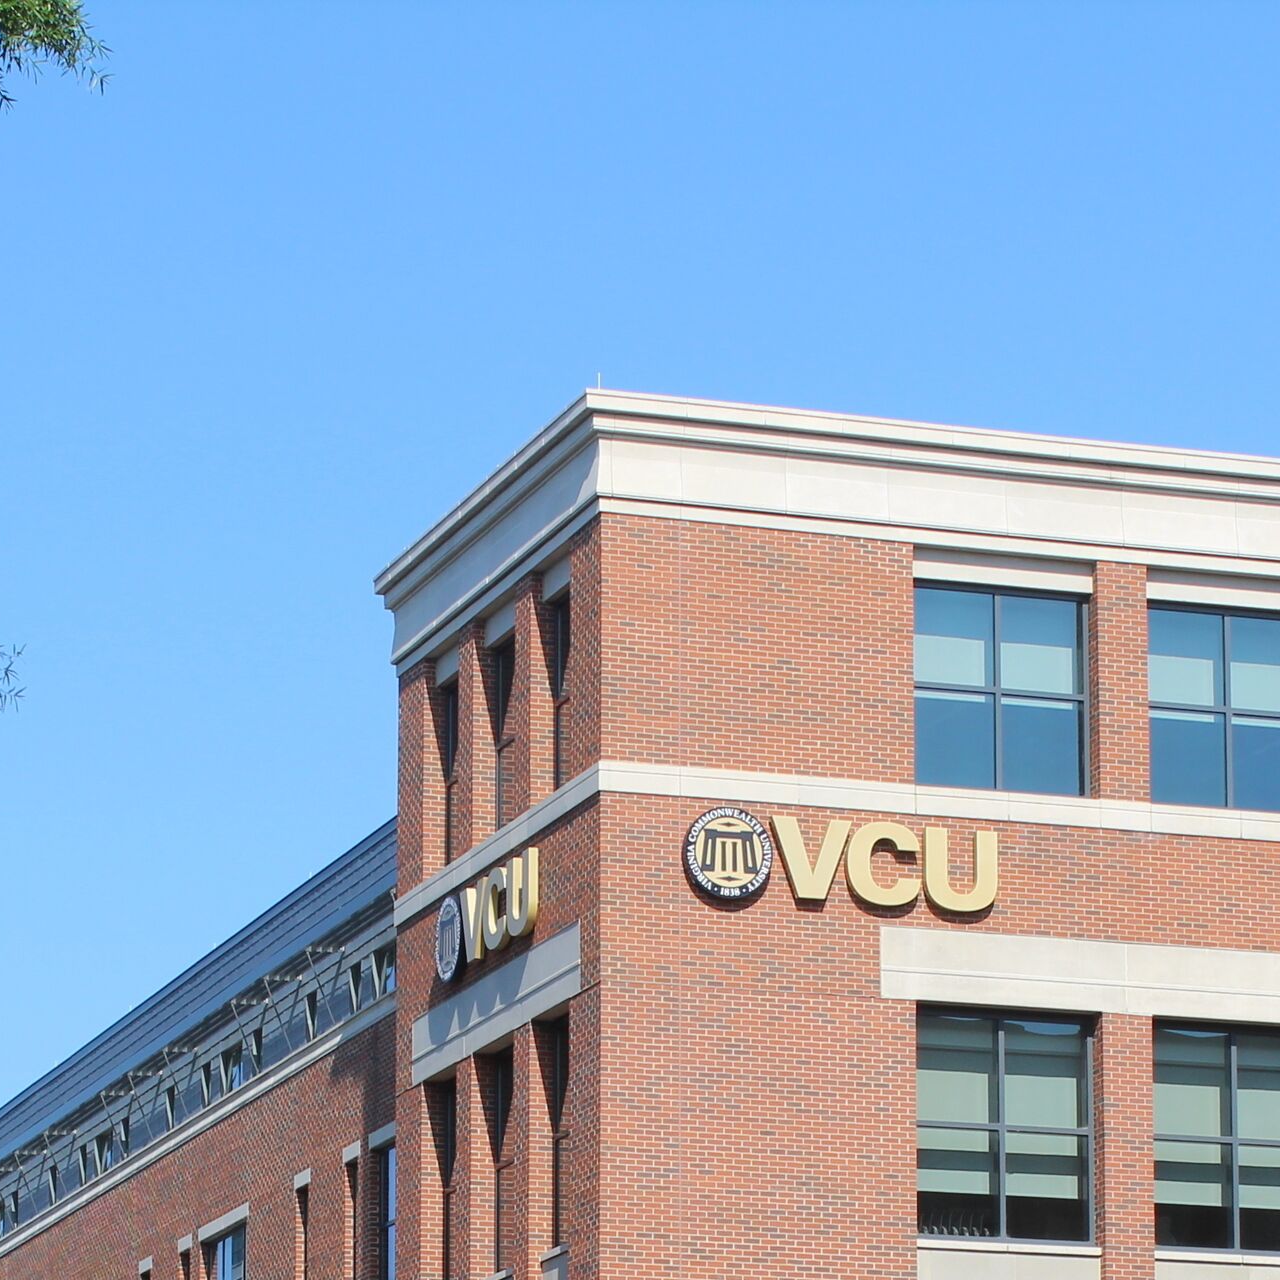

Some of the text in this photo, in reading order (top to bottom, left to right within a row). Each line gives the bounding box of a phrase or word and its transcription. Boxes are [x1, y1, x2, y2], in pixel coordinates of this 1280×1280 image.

[687, 808, 773, 893] VIRGINIA COMMONWEALTH UNIVERSITY
[719, 886, 741, 898] 1838
[771, 815, 999, 913] VCU
[460, 847, 540, 964] VCU
